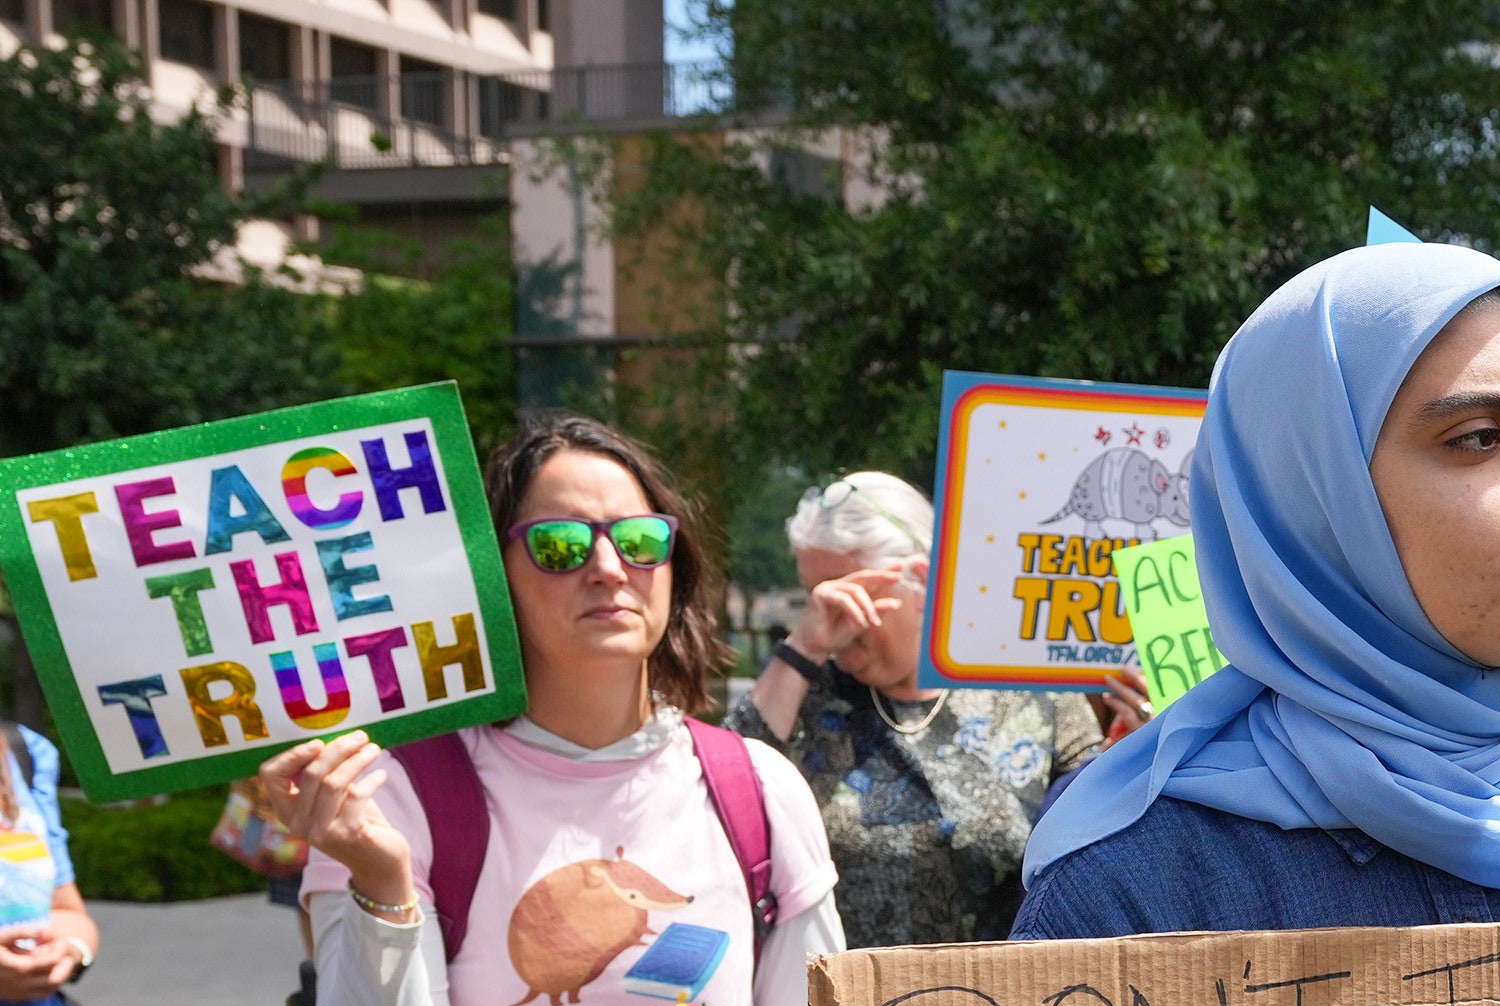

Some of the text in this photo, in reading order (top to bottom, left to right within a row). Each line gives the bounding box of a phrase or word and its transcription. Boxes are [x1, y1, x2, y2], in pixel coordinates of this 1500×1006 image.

[26, 430, 447, 582] TEACH
[145, 532, 394, 657] THE
[98, 612, 486, 759] TRUTH
